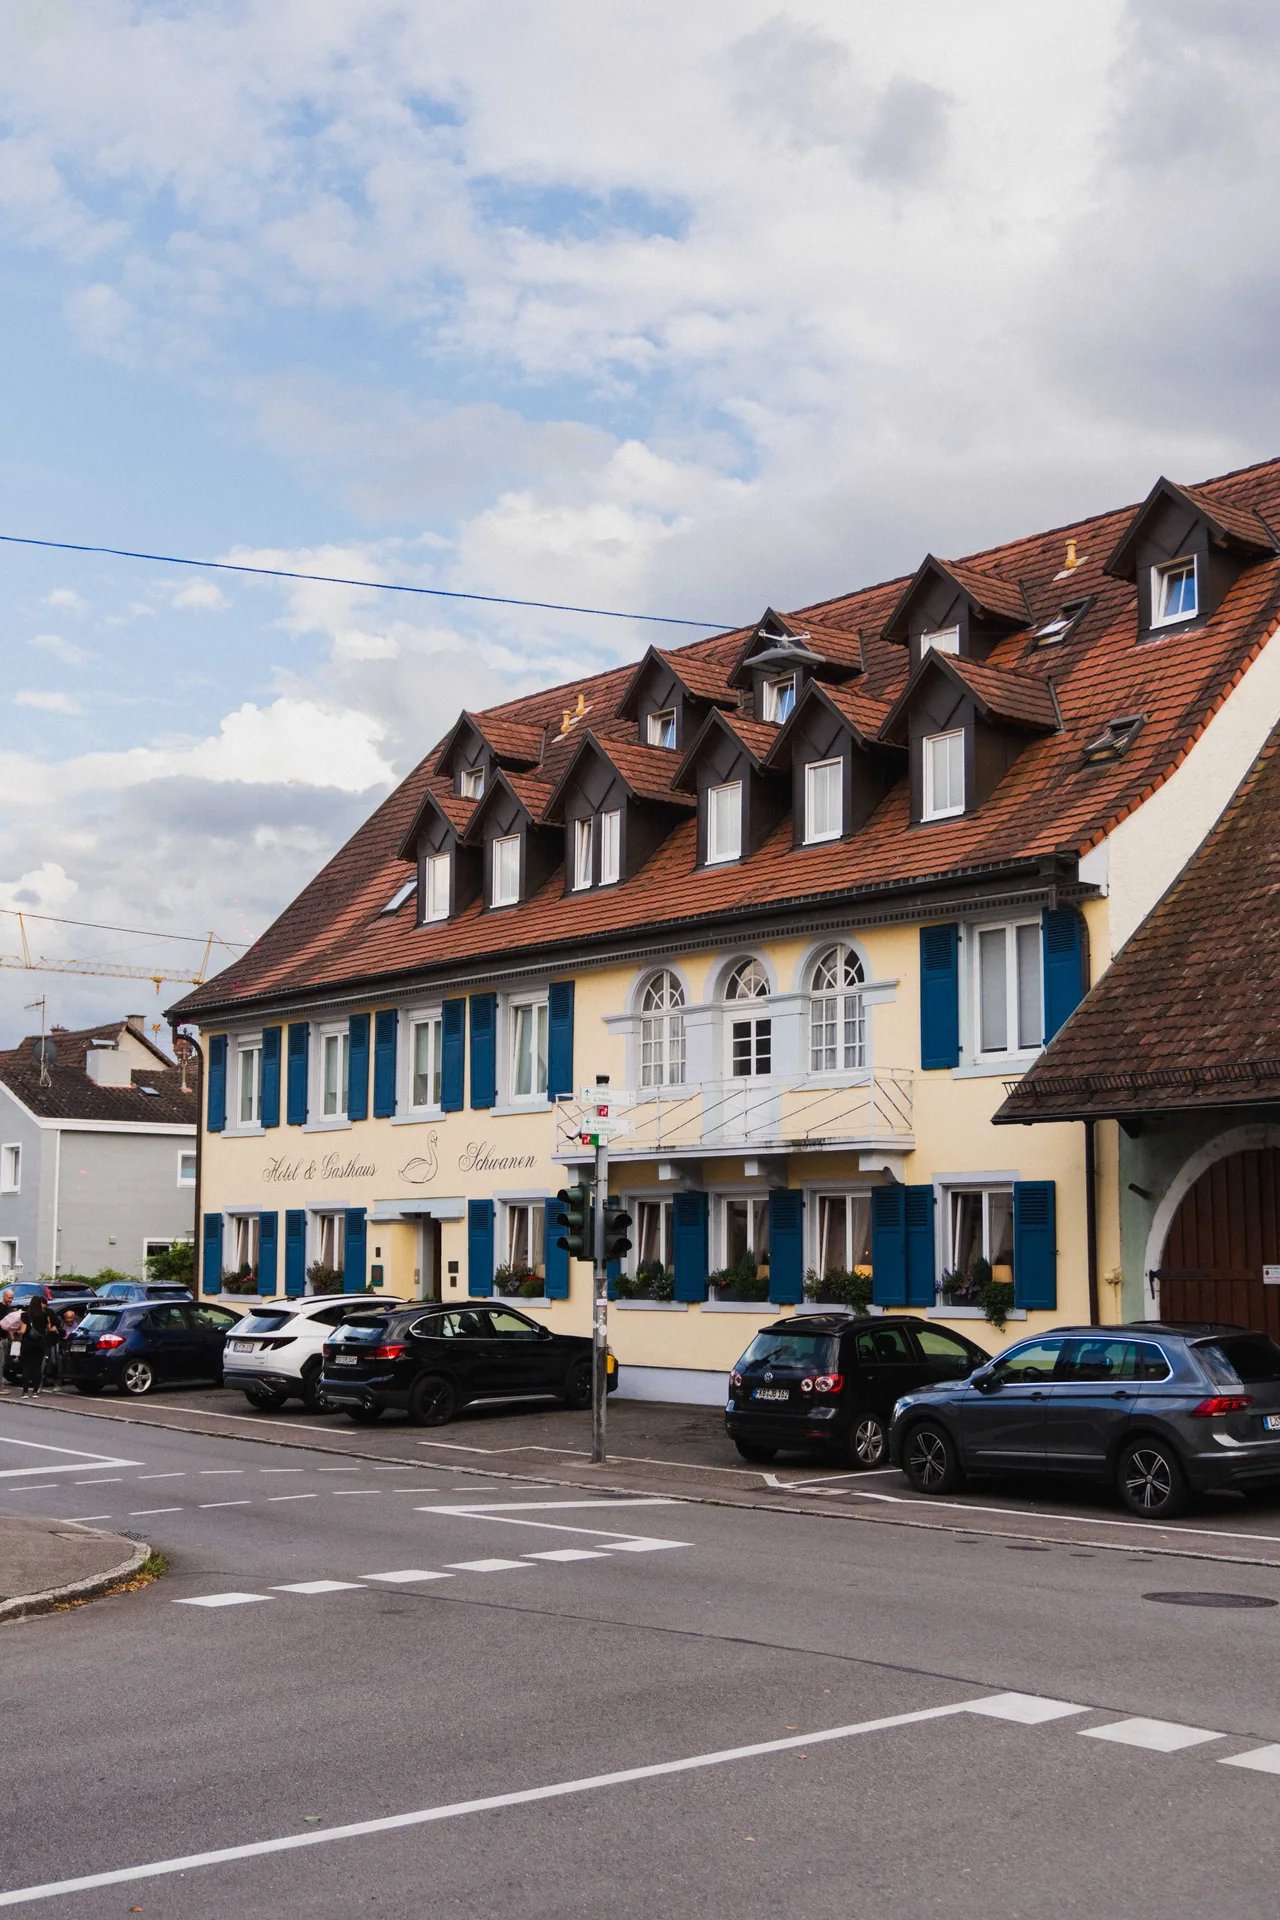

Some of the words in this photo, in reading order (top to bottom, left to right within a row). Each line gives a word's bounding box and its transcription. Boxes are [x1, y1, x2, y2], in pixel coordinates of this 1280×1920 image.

[262, 1155, 303, 1182] Hotel
[303, 1160, 316, 1180] &
[321, 1152, 378, 1179] Gasthaus
[458, 1141, 538, 1172] Schwanen
